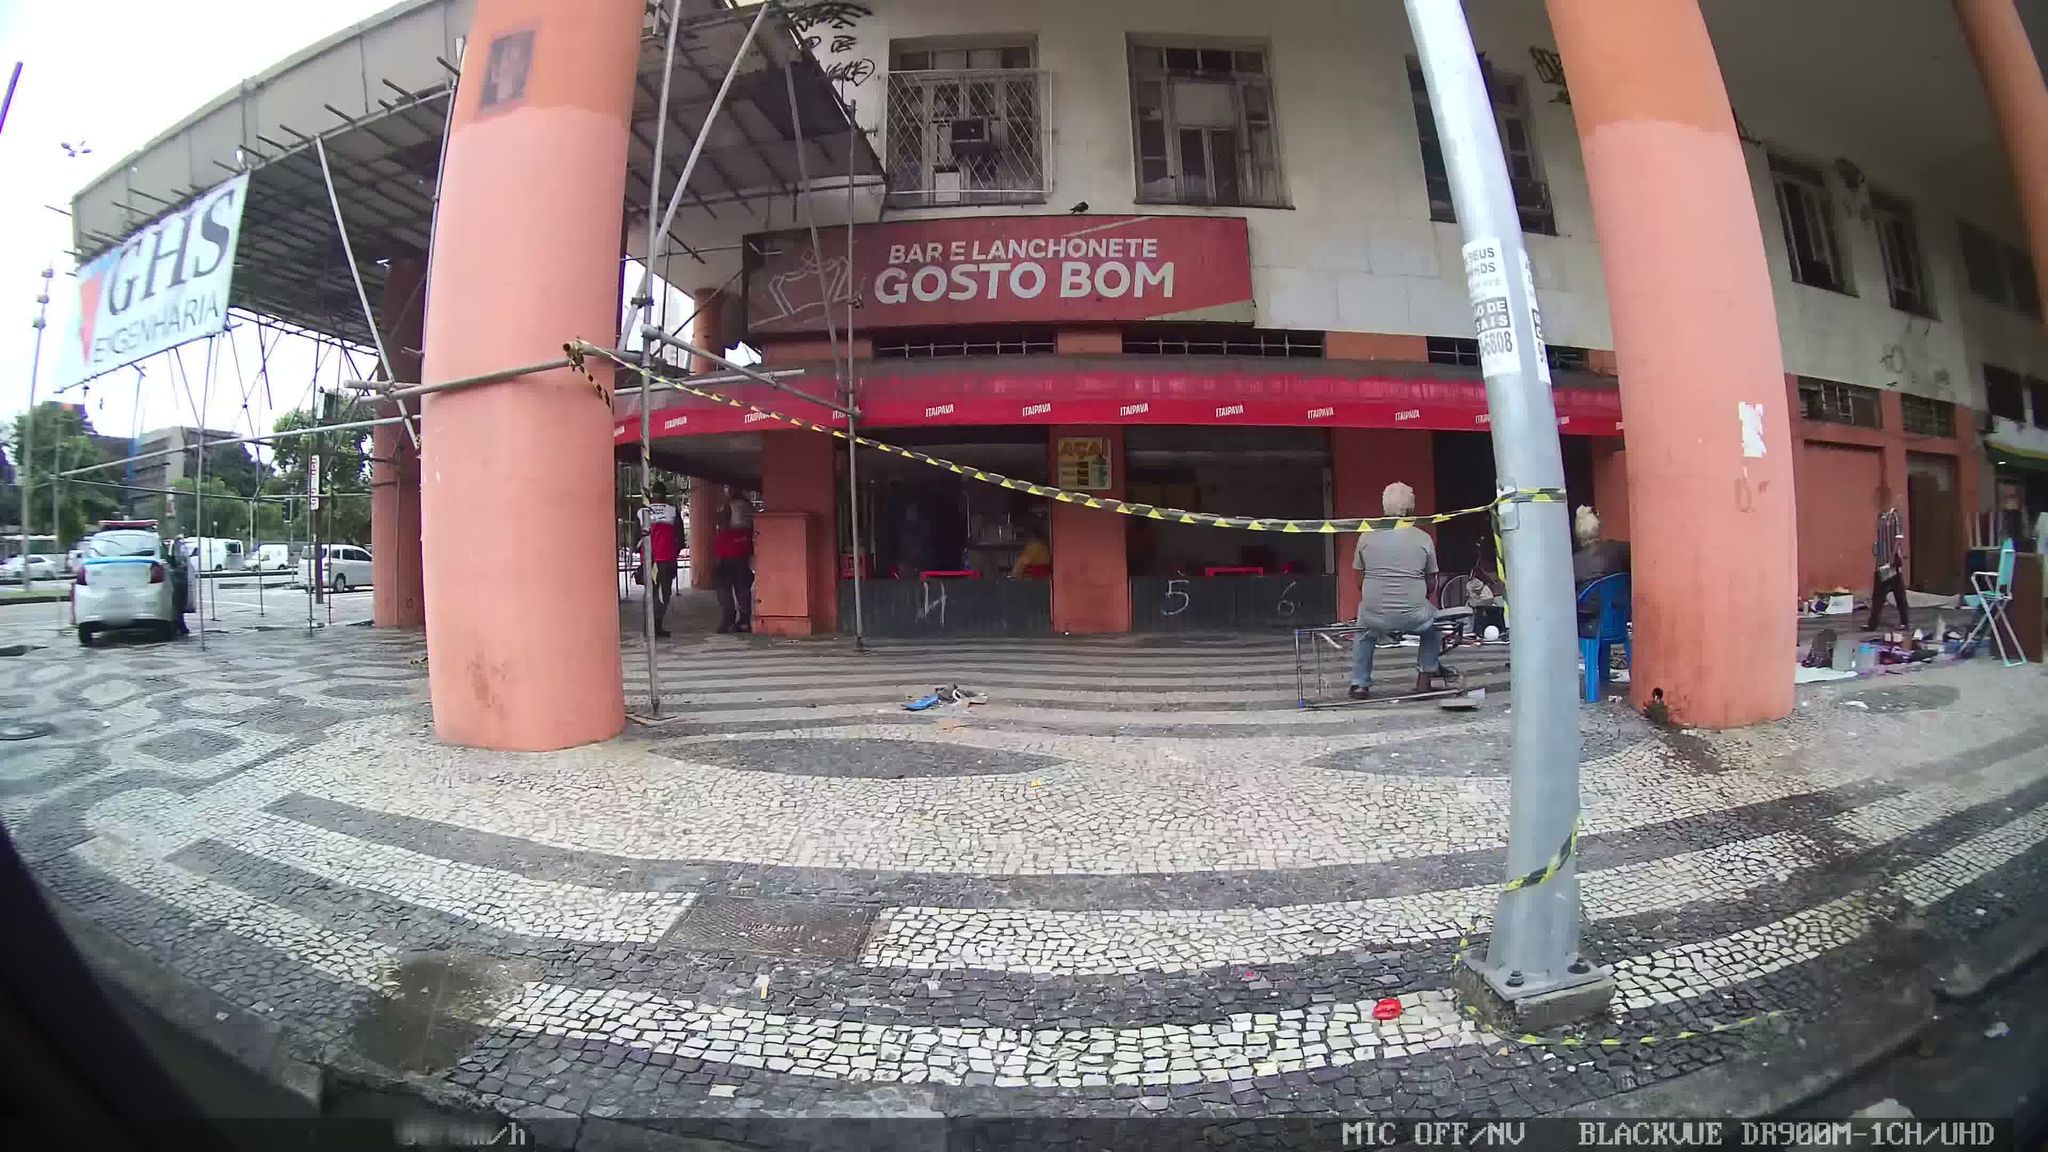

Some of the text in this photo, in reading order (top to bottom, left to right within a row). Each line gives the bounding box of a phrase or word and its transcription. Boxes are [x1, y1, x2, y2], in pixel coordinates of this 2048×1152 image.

[109, 187, 236, 316] GHS
[888, 238, 1157, 264] BAR E LANCHONETE
[874, 261, 1174, 304] GOSTO BOM
[925, 404, 954, 417] ITAIPAVA
[1022, 403, 1051, 417] ITAIPAVA
[1120, 403, 1149, 417] ITAIPAVA
[1216, 404, 1244, 418] ITAIPAVA
[1307, 406, 1335, 419] ITAIPAVA
[1160, 579, 1190, 615] 5
[1277, 581, 1297, 616] 6
